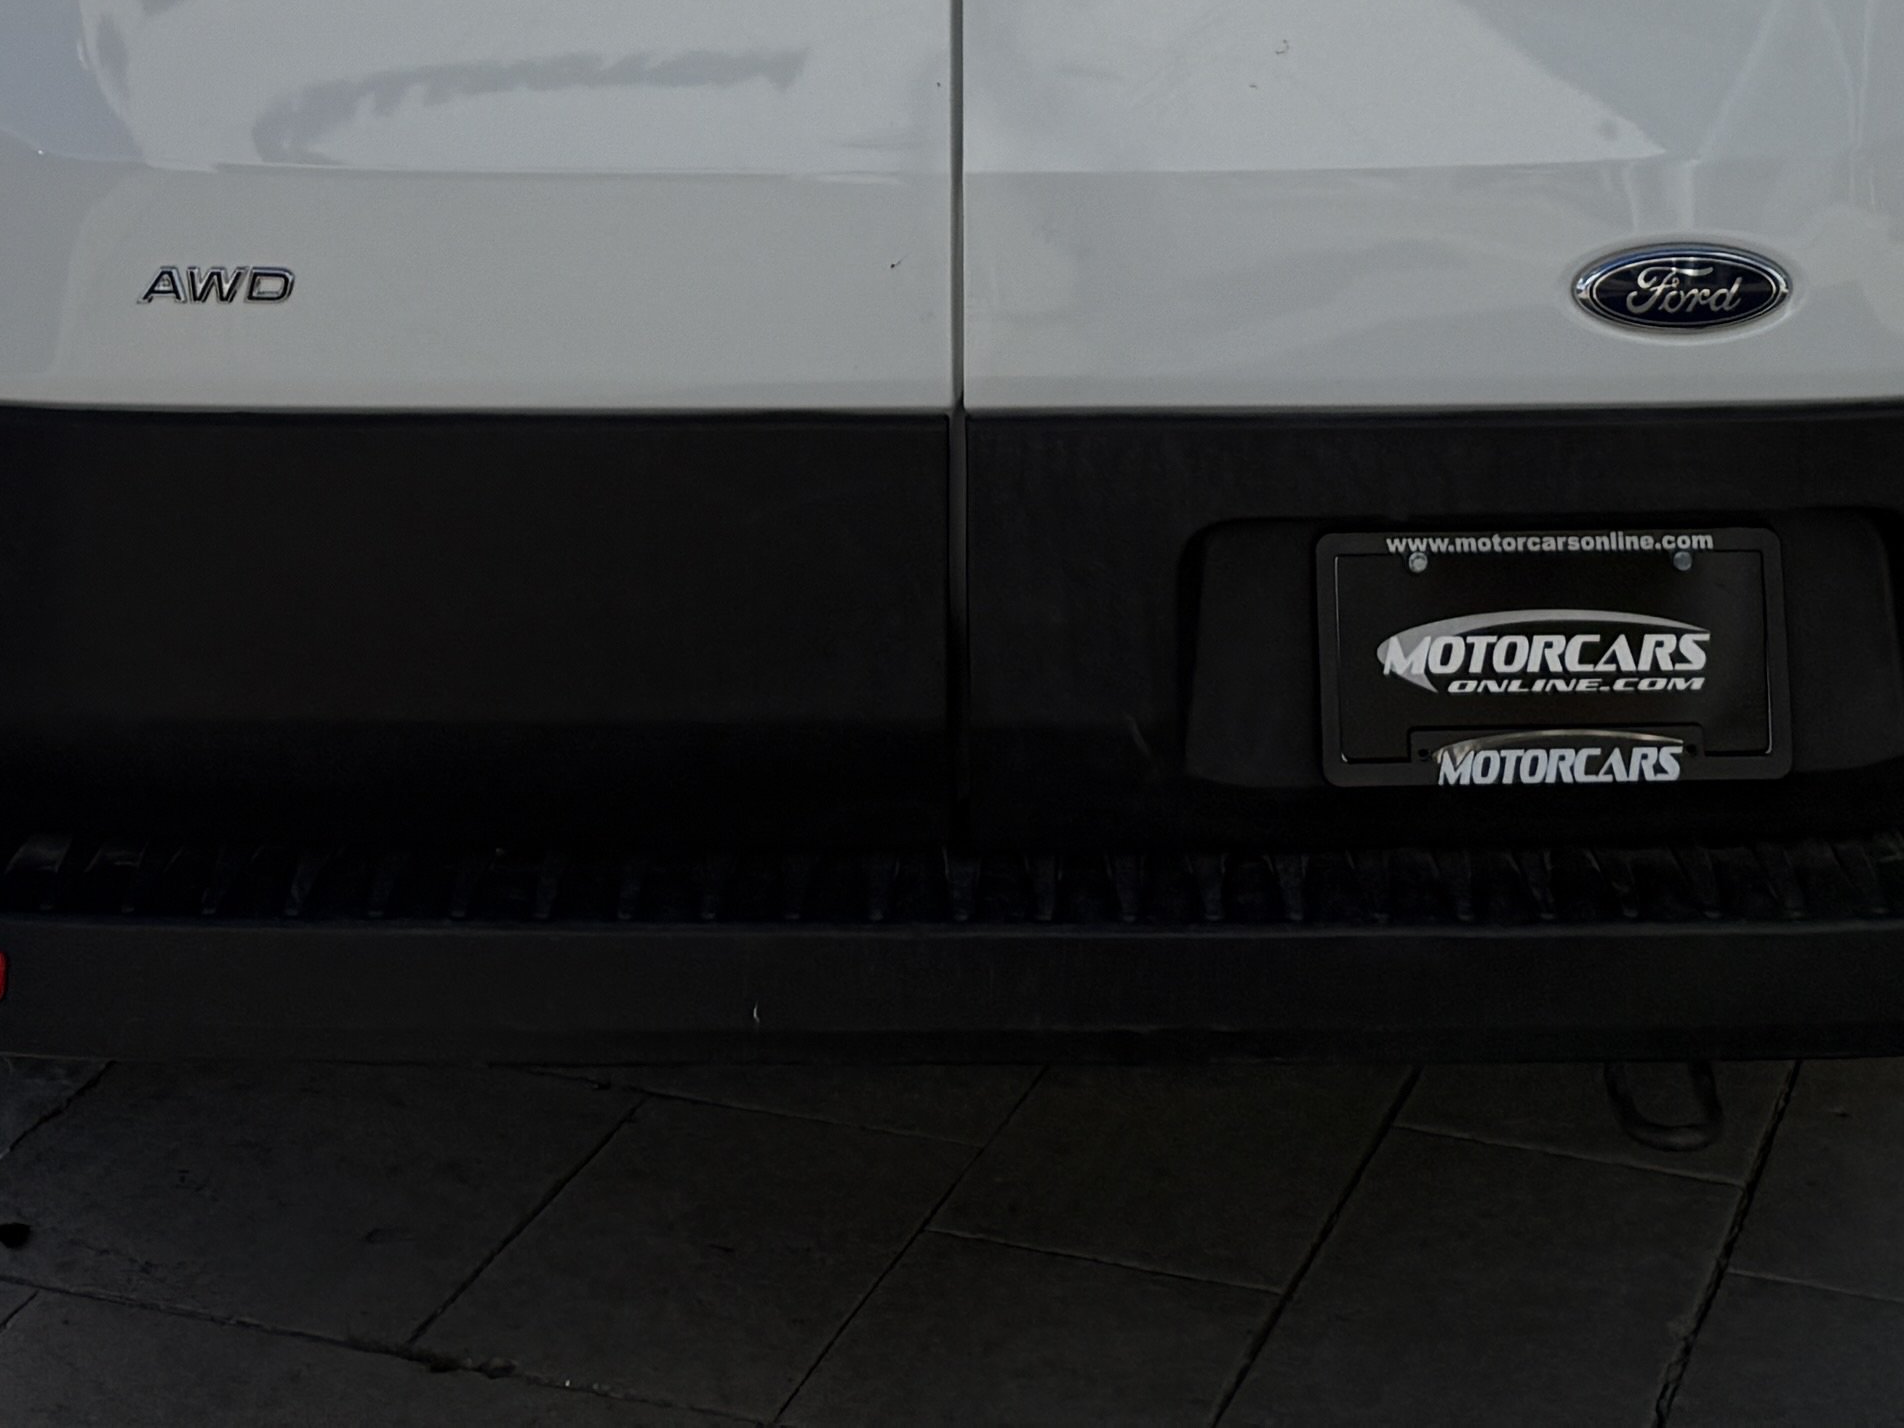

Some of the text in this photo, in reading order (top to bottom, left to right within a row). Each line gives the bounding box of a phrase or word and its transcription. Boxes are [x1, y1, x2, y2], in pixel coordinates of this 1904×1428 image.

[137, 265, 295, 304] AWD
[1626, 266, 1744, 314] Ford
[1386, 531, 1714, 553] www.motorcarsonline.com
[1382, 634, 1711, 676] MOTORCARS
[1447, 676, 1706, 694] ONLINE.COM
[1437, 746, 1684, 787] MOTORCARS
